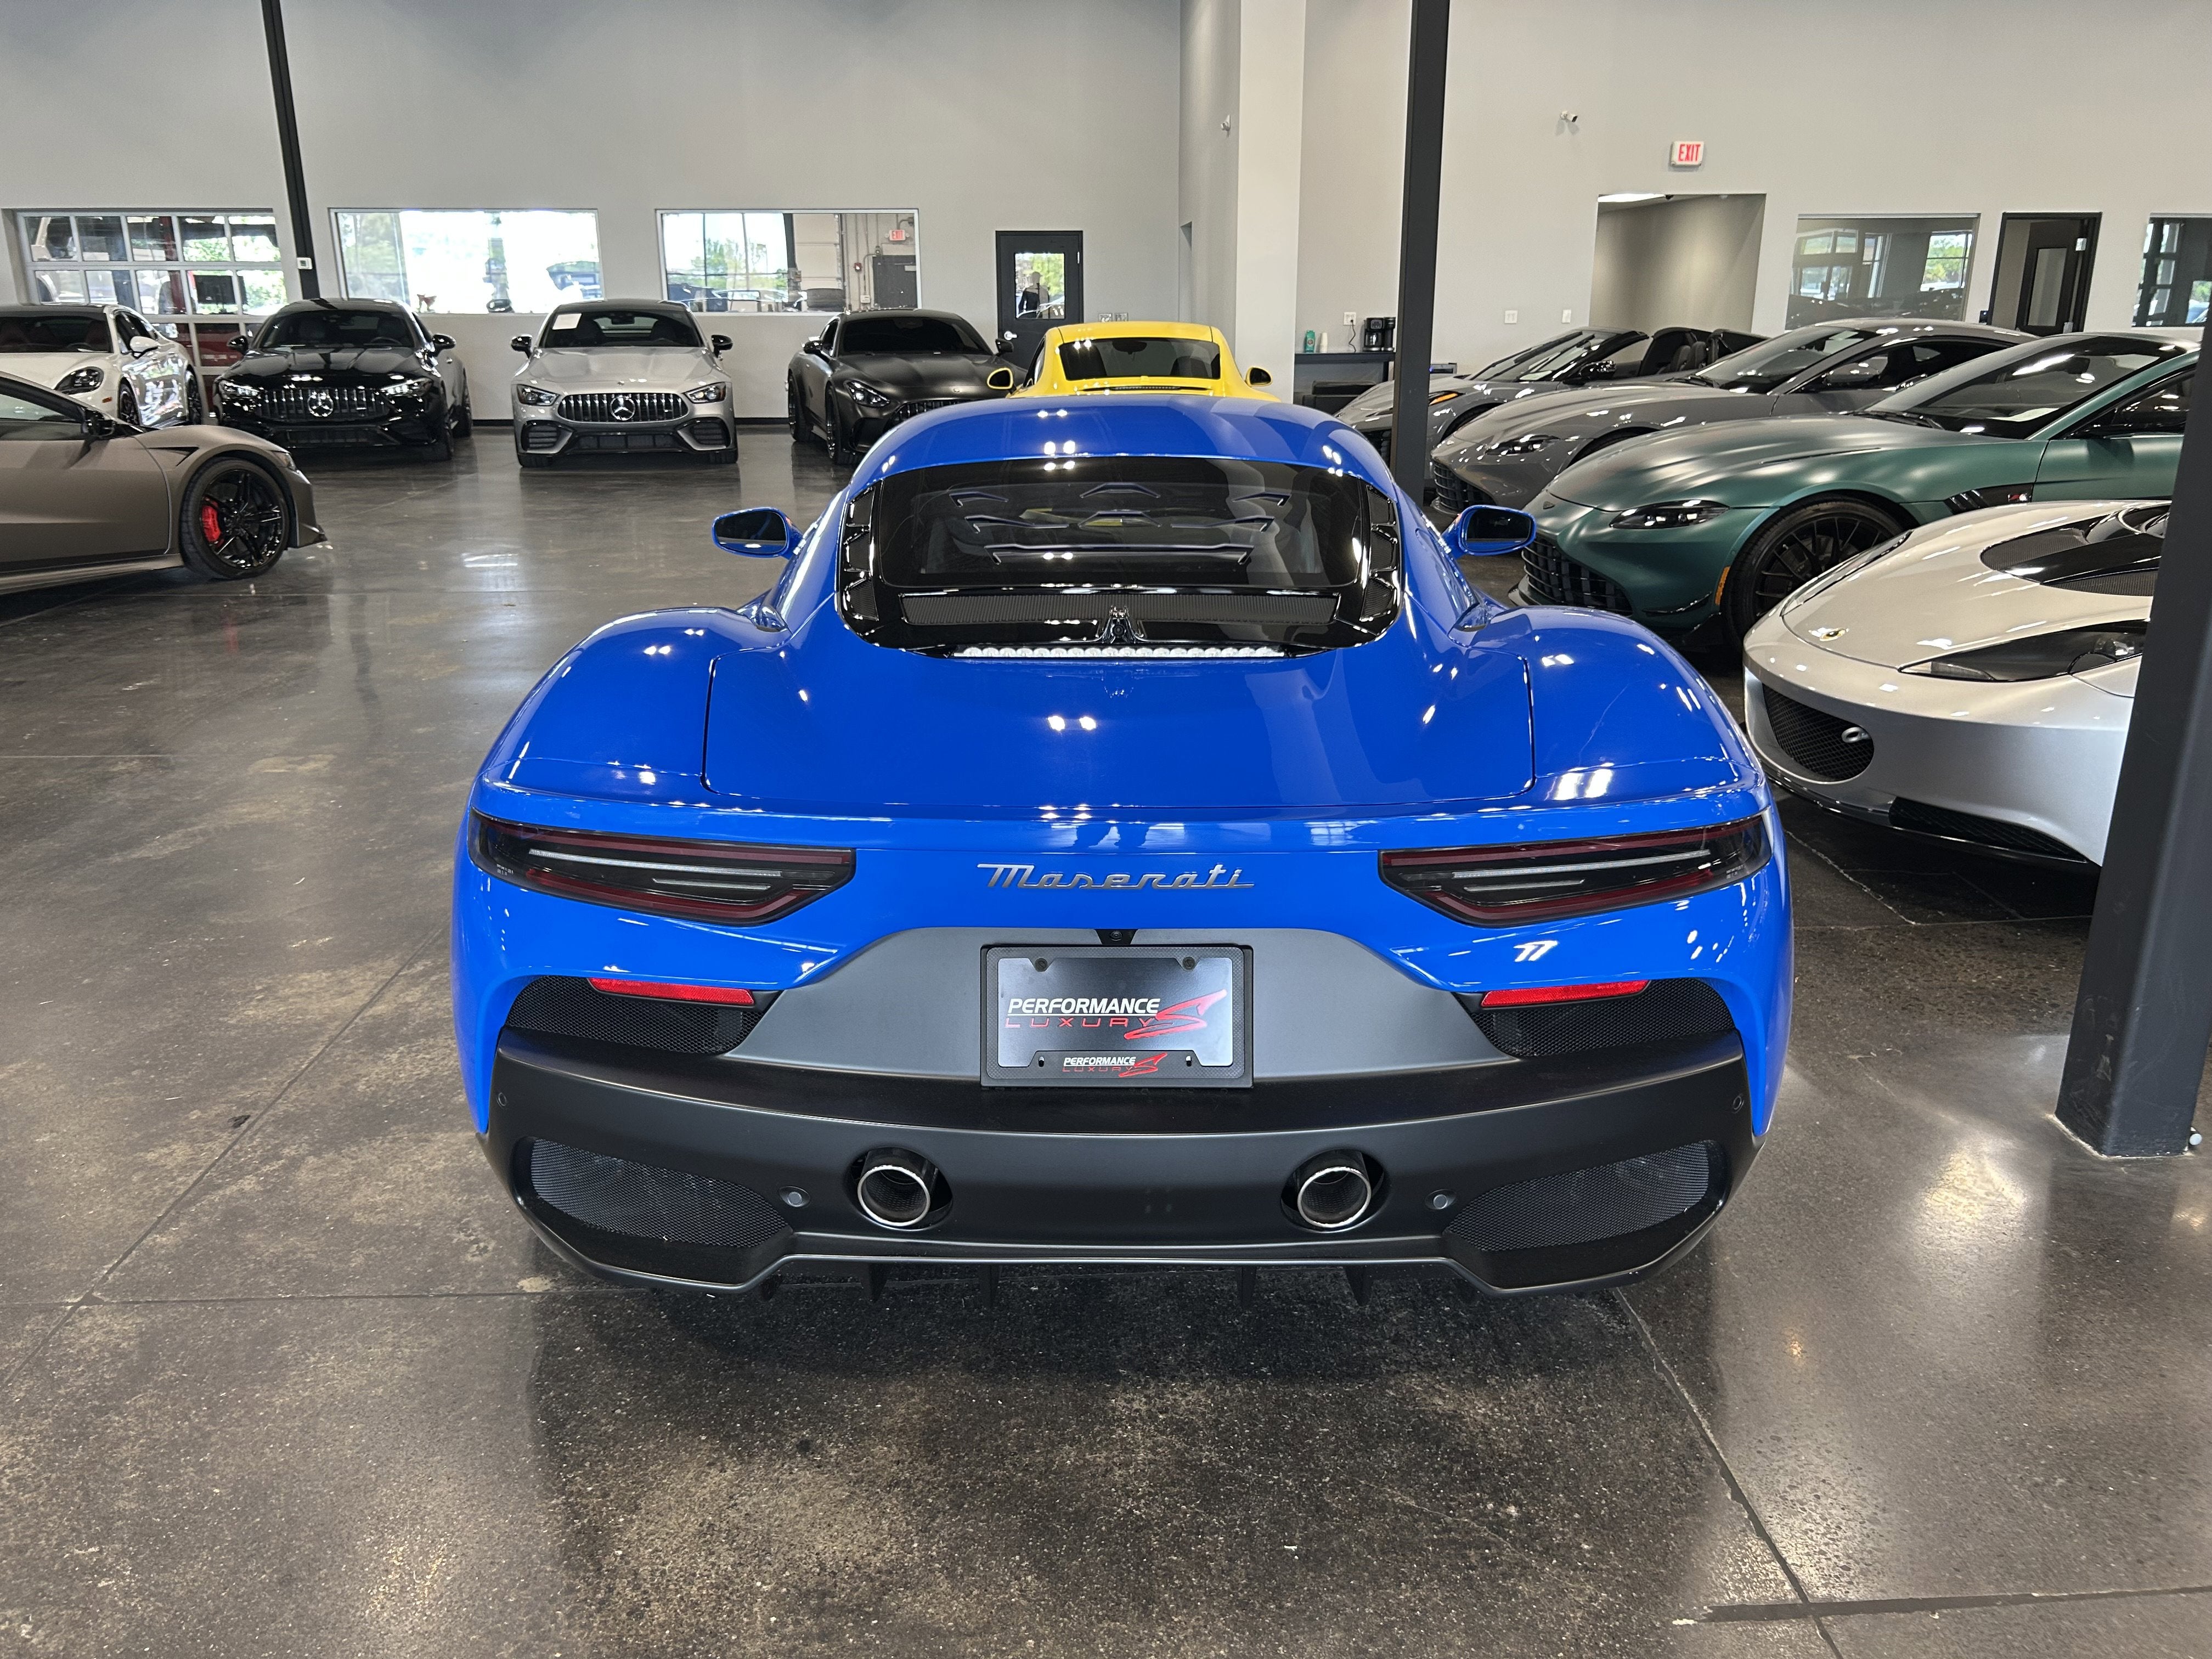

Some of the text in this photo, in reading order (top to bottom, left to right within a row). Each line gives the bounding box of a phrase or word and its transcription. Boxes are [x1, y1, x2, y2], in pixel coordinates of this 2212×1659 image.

[1678, 144, 1701, 161] EXIT
[977, 864, 1255, 889] Maserati
[1007, 998, 1161, 1014] PERFORMANCE
[1004, 1017, 1154, 1028] LUXURY
[1063, 1056, 1137, 1065] PERFORMANCE
